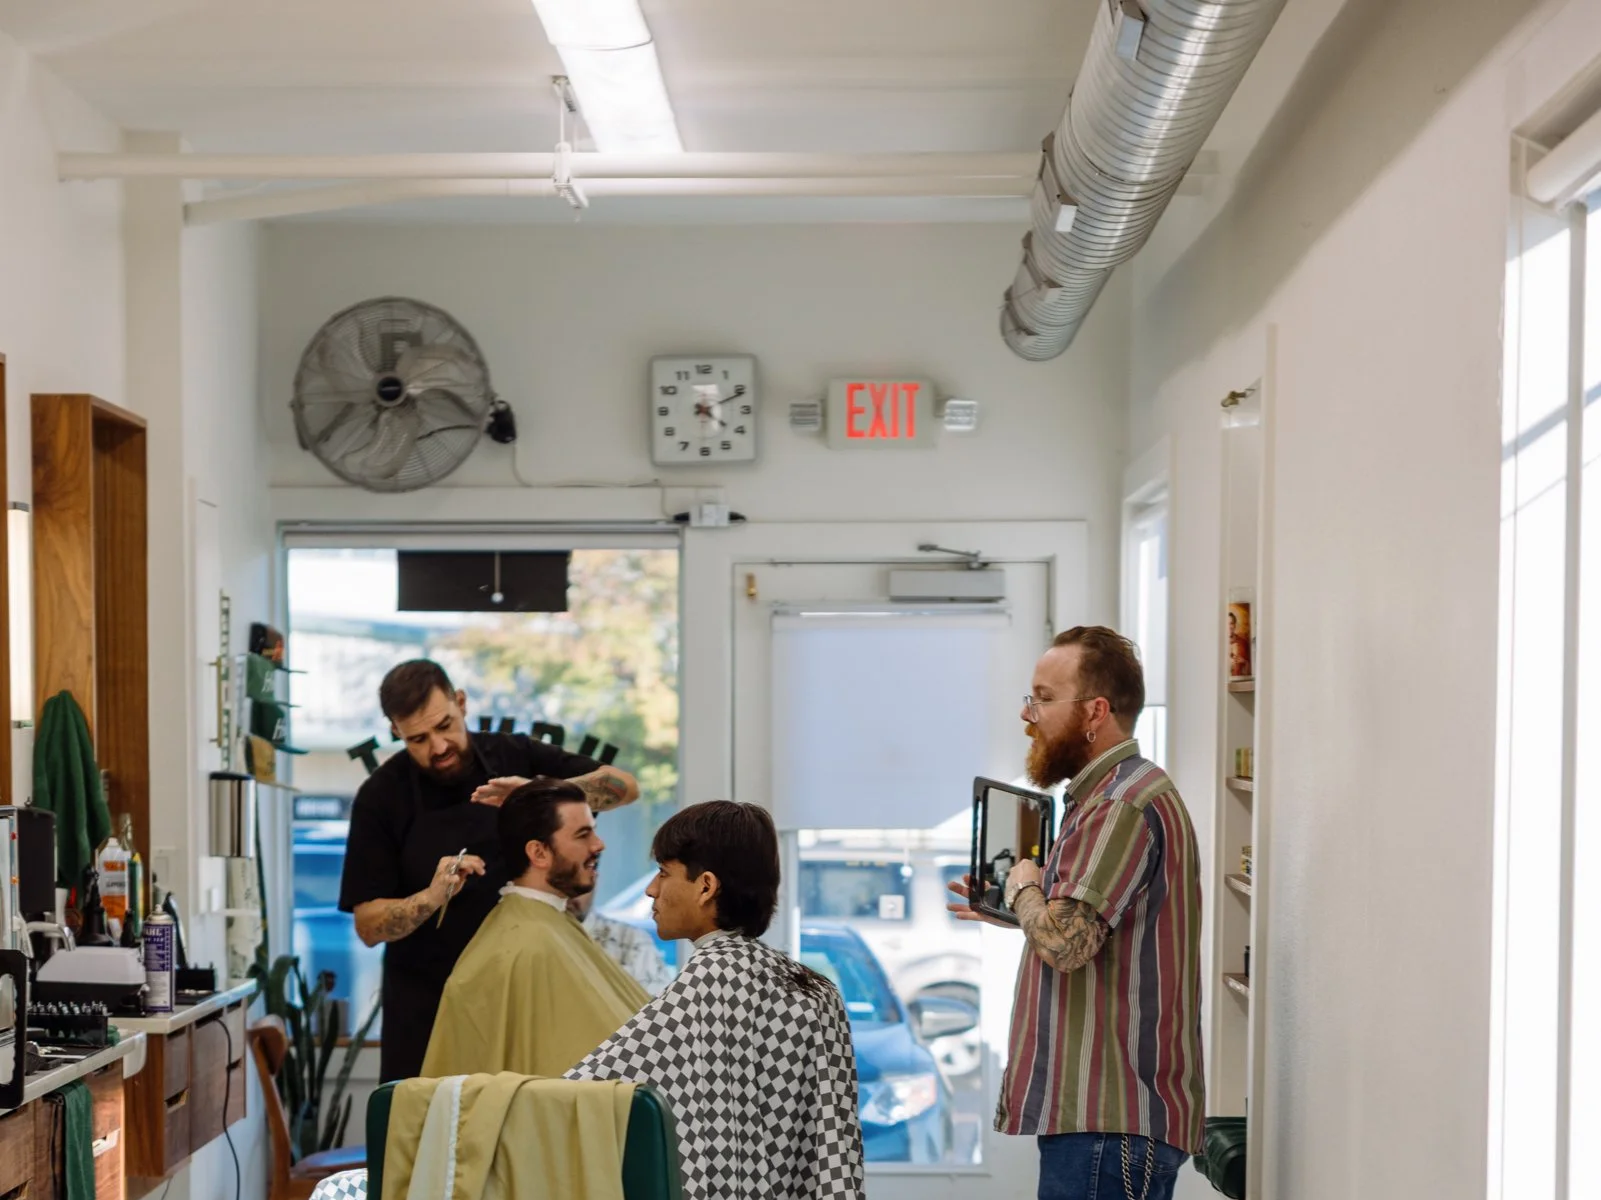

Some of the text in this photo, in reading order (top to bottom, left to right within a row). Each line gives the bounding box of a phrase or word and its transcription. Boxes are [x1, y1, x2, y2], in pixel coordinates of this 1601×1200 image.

[694, 364, 713, 375] 12
[722, 369, 729, 380] 1
[675, 370, 690, 381] 11
[659, 385, 678, 396] 10
[734, 384, 746, 396] 2
[657, 406, 669, 417] 9
[740, 404, 752, 415] 3
[846, 383, 920, 439] EXIT
[663, 426, 675, 437] 8
[733, 425, 747, 436] 4
[679, 441, 690, 452] 7
[720, 440, 732, 451] 5
[699, 446, 711, 457] 6
